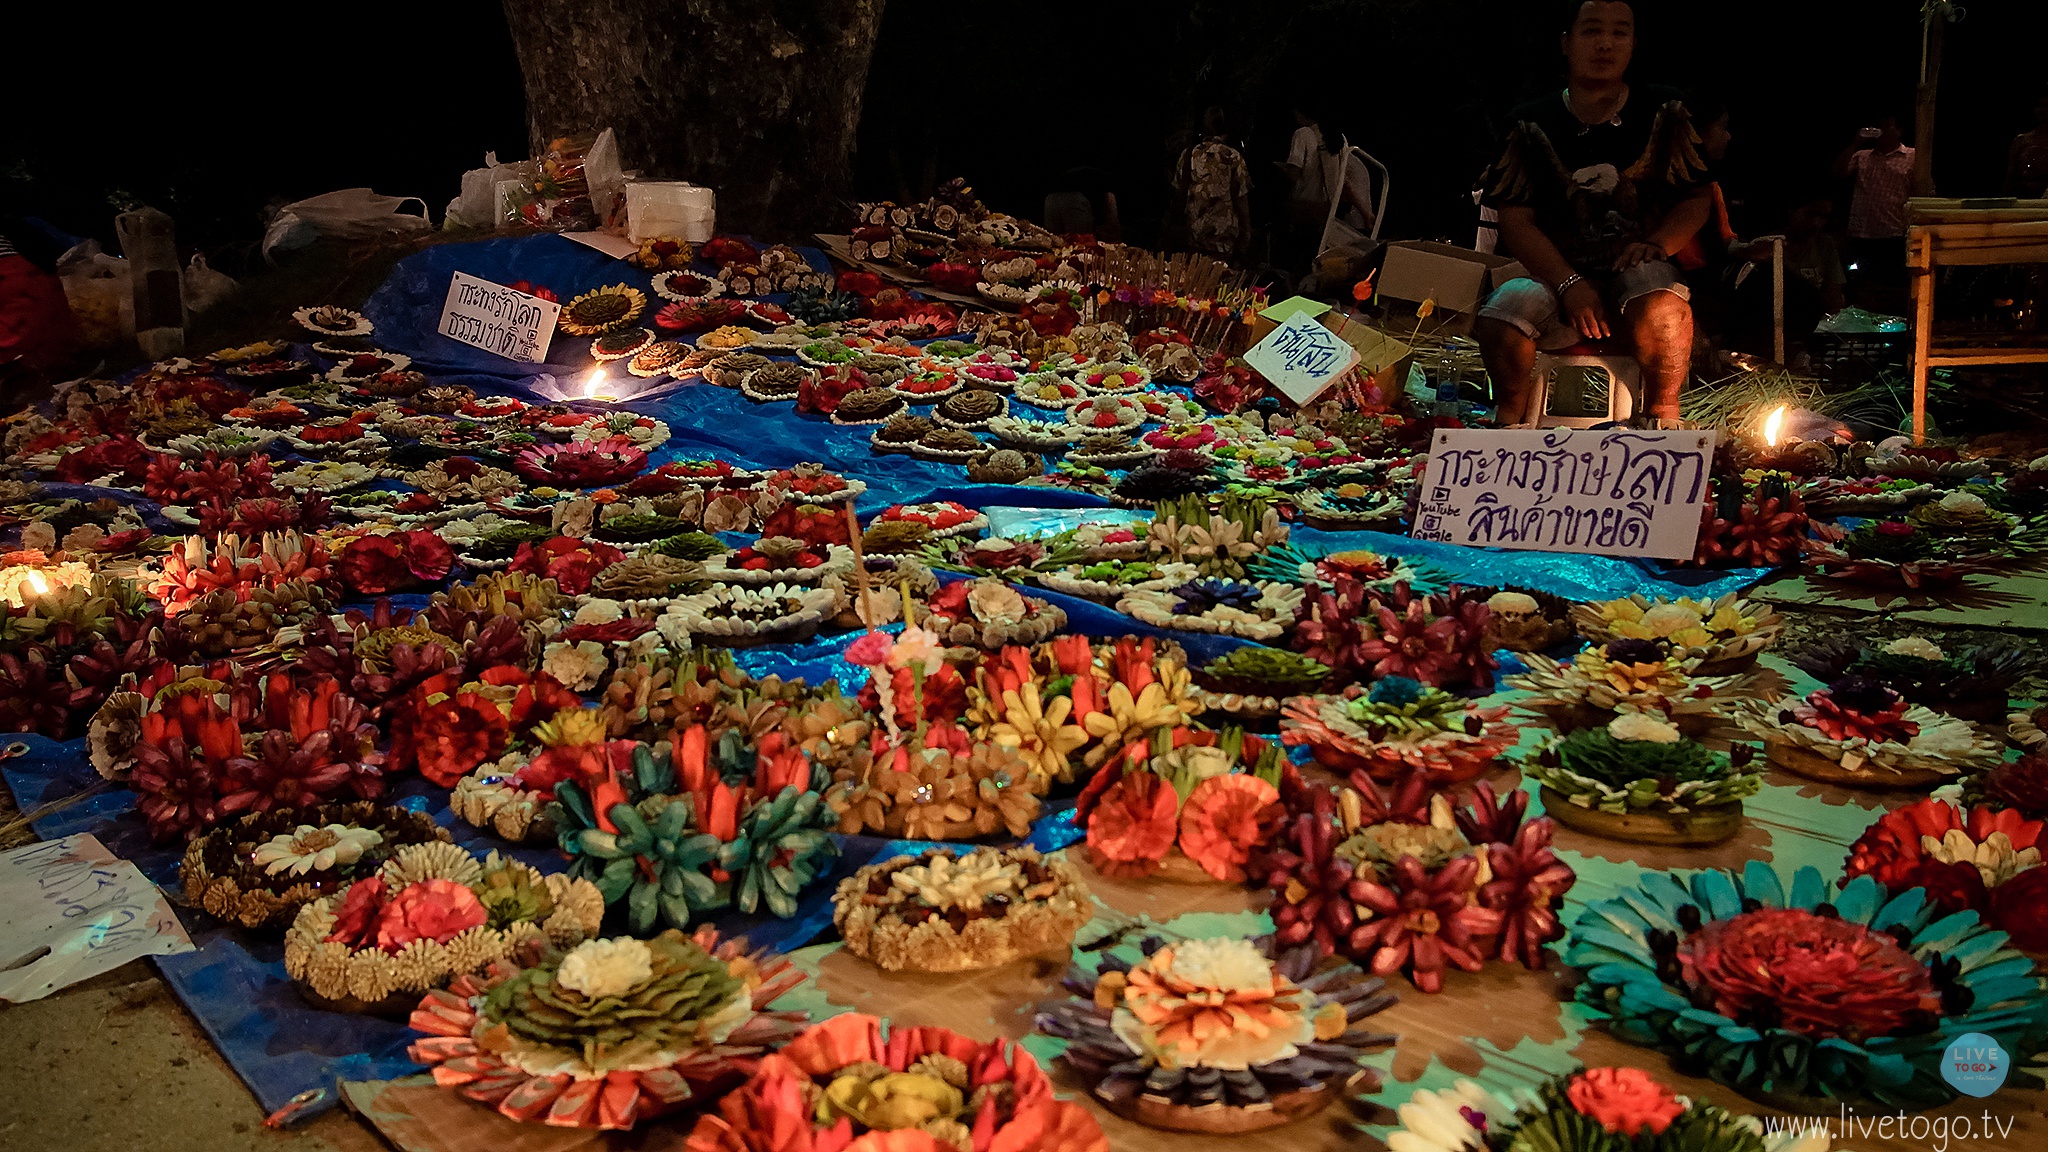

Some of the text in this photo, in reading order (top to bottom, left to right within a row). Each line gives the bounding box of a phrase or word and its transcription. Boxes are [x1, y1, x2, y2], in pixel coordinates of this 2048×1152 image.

[458, 283, 542, 329] กระทงรักโลก
[447, 312, 519, 356] ธรรมชาติ
[1436, 432, 1704, 505] กระทงรักษ์โลก
[1419, 502, 1461, 517] YouTube
[1467, 491, 1655, 549] สินค้าขายดี
